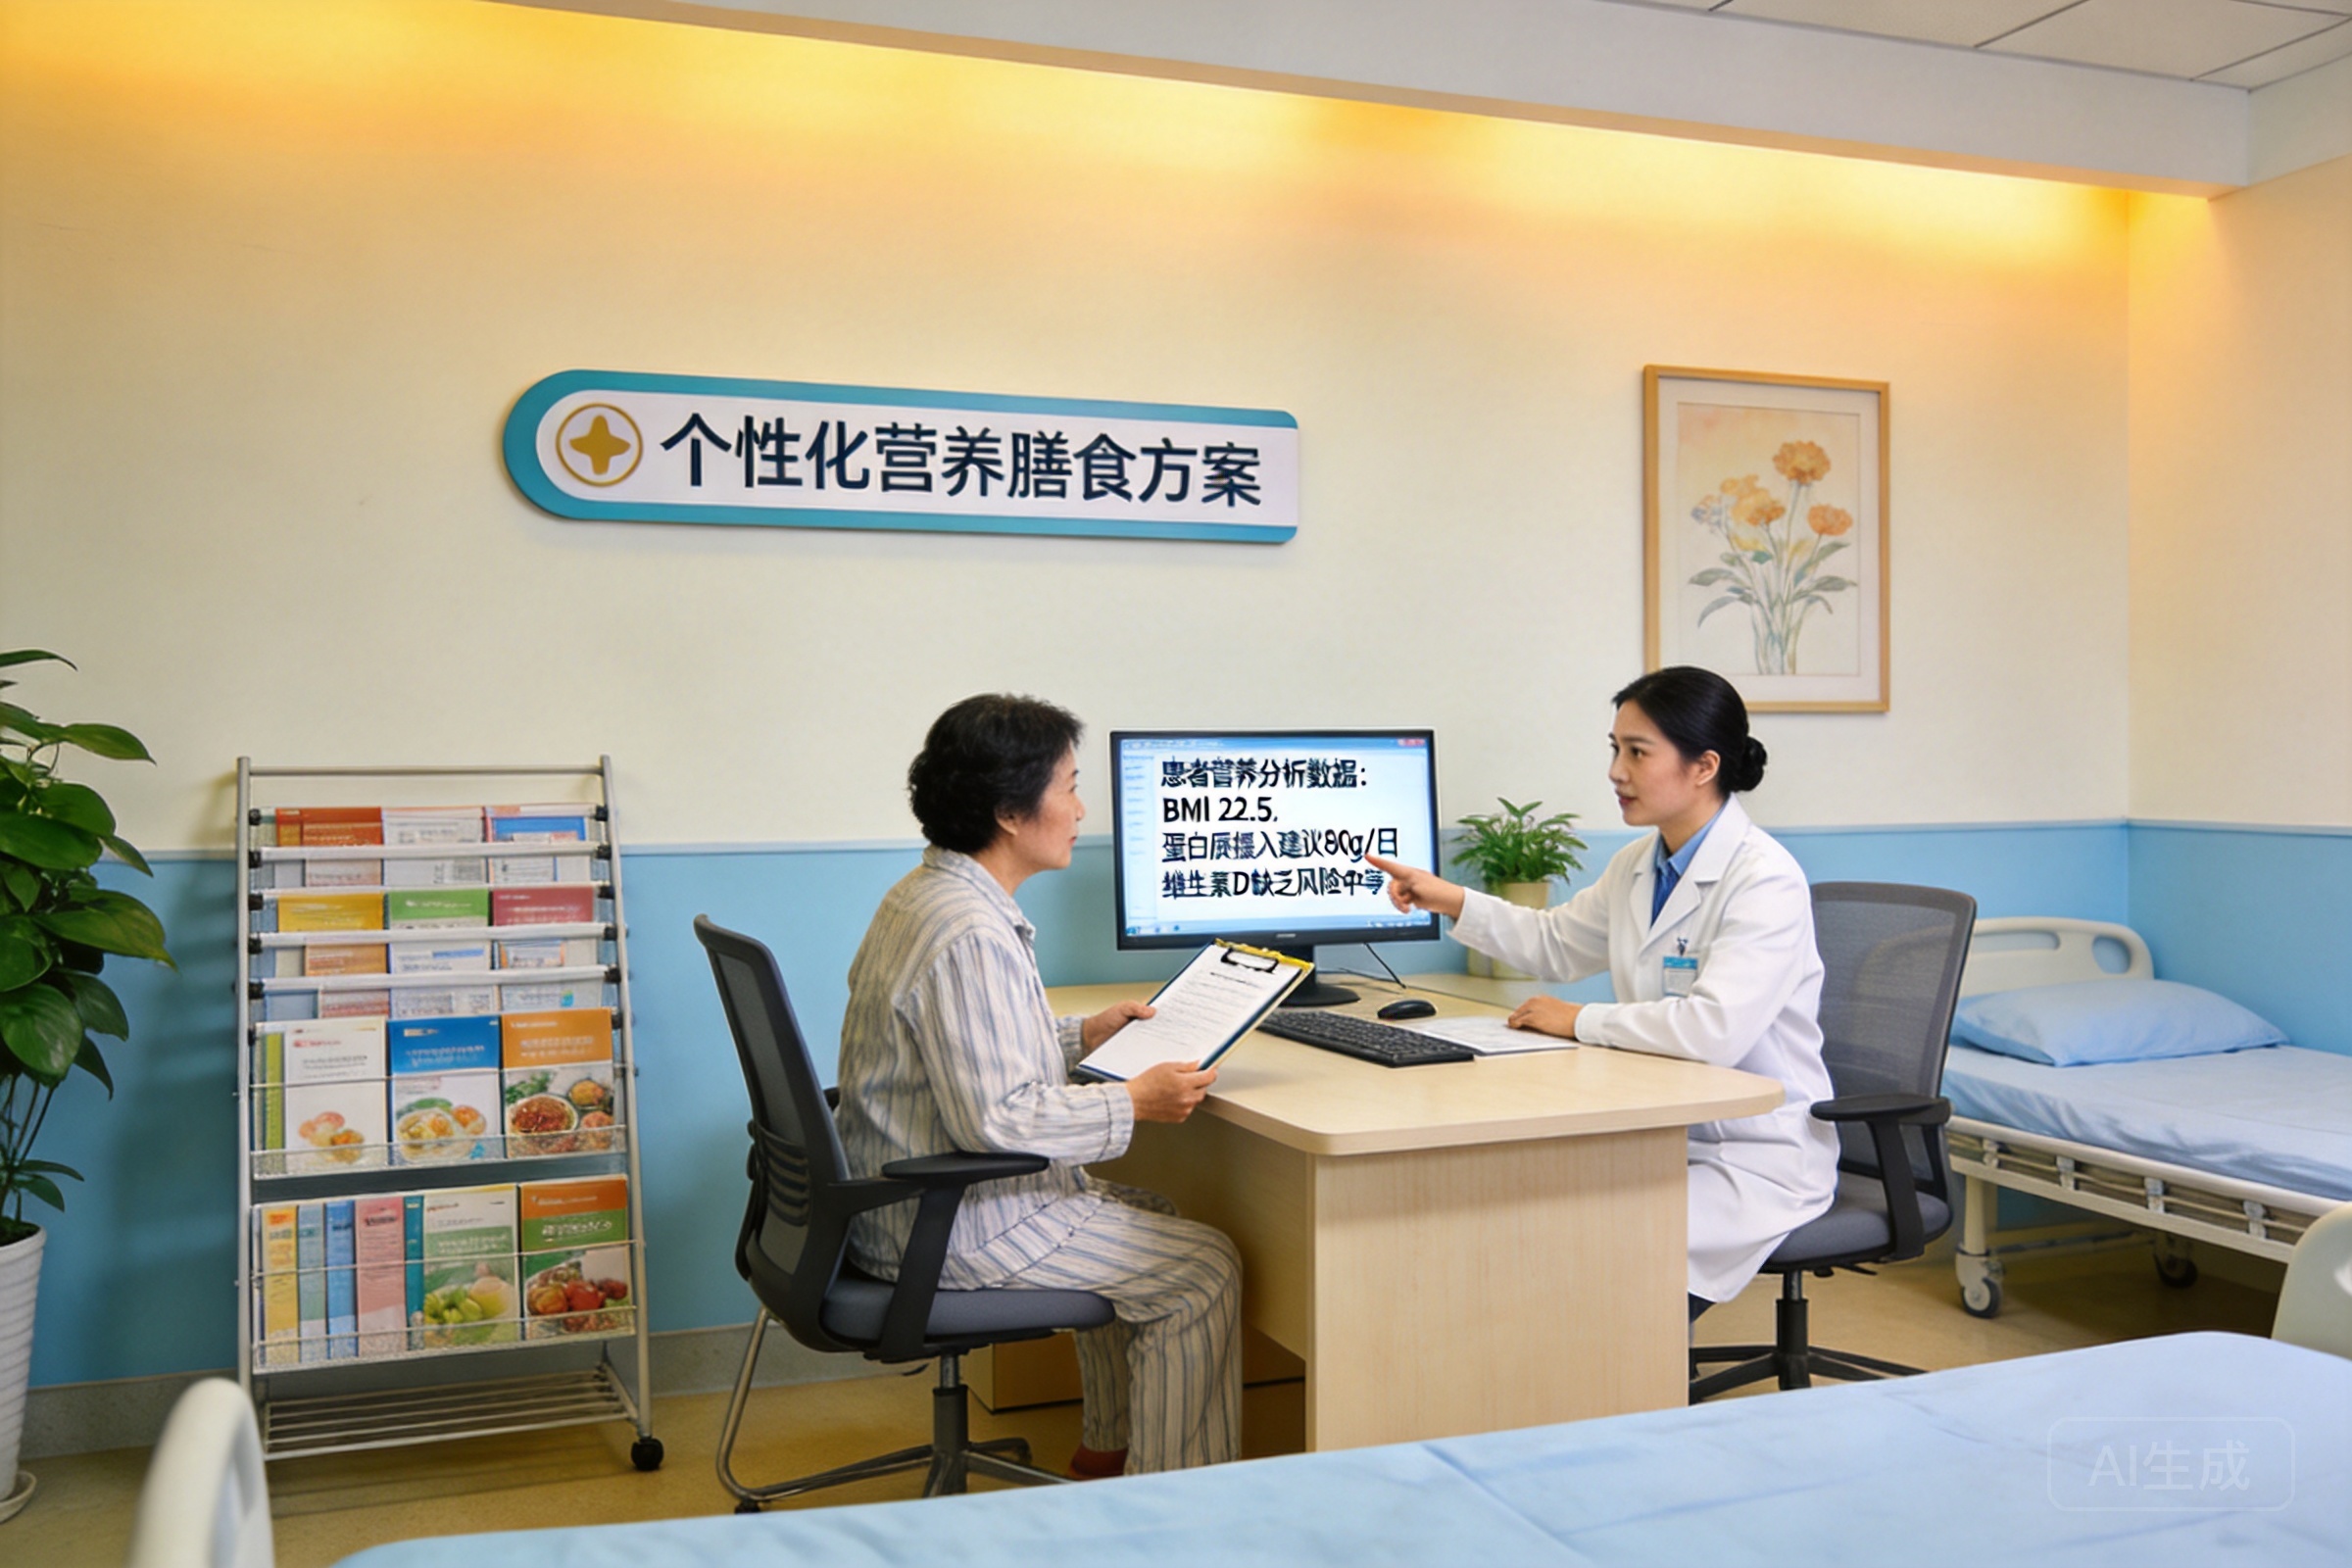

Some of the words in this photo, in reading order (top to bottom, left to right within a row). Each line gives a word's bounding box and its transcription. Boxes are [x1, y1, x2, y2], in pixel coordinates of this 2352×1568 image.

[661, 413, 1261, 508] 个性化营养膳食方案
[1162, 796, 1210, 823] BMI
